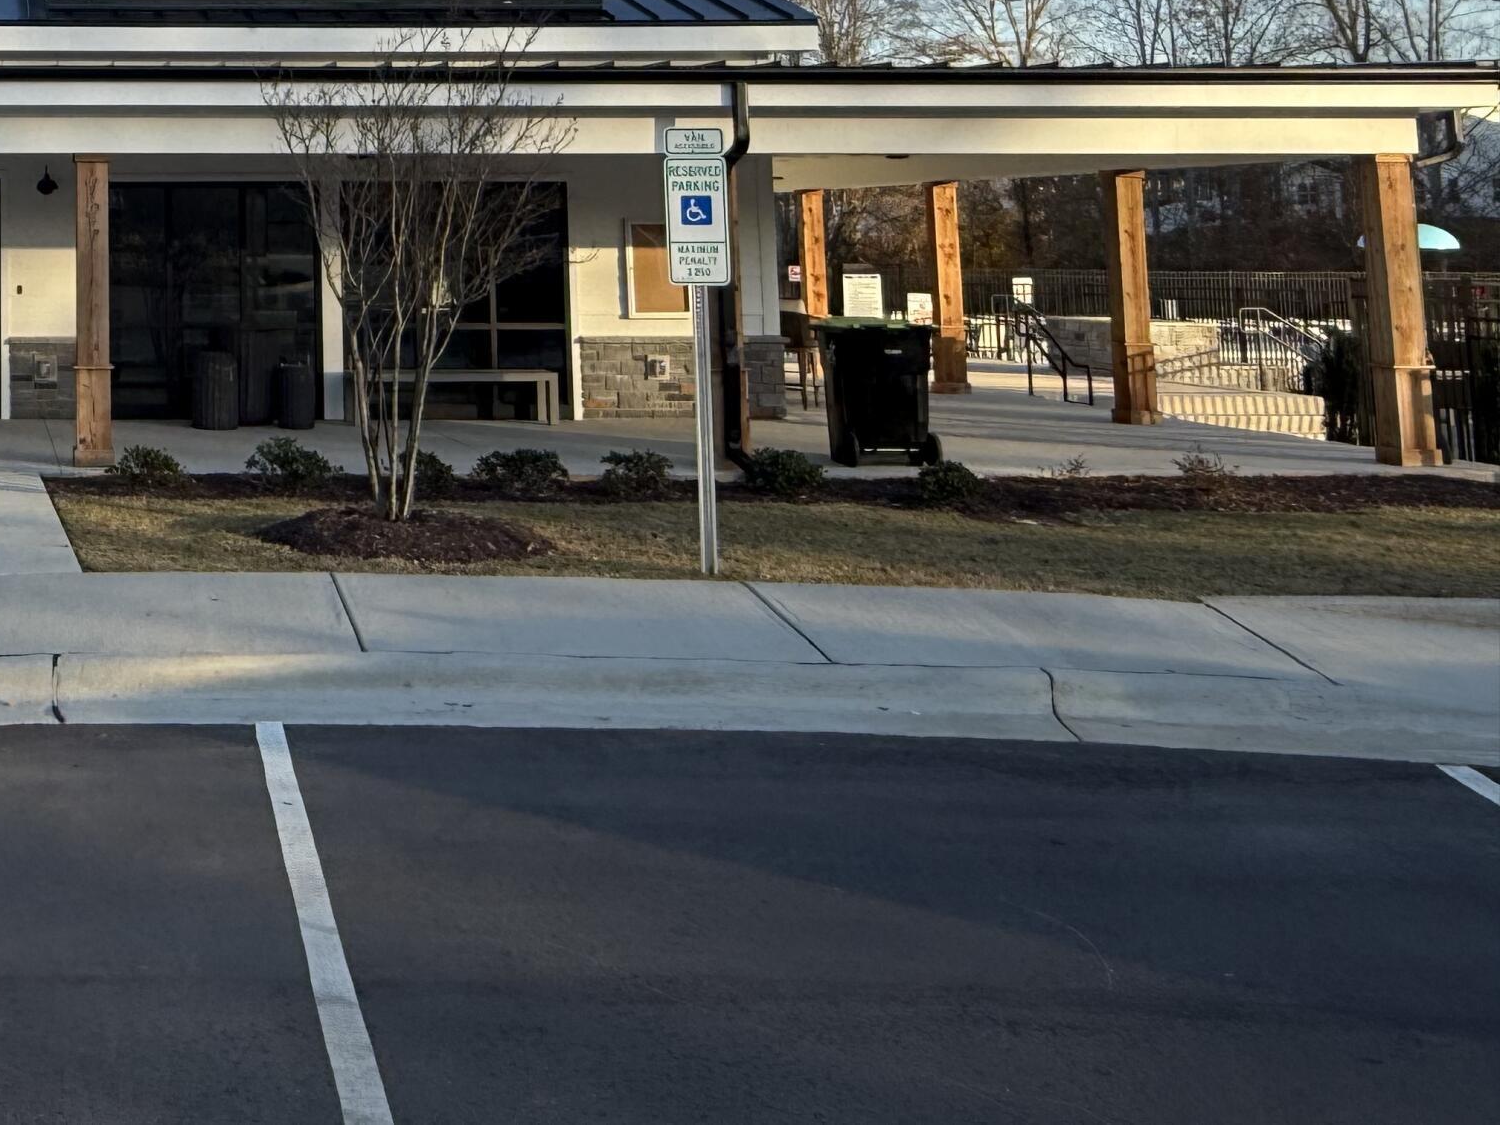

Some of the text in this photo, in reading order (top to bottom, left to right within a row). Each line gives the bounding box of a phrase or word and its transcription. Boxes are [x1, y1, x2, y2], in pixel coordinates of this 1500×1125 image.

[668, 166, 721, 177] RESERVED
[672, 180, 720, 192] PARKING
[679, 256, 717, 265] PENALTY
